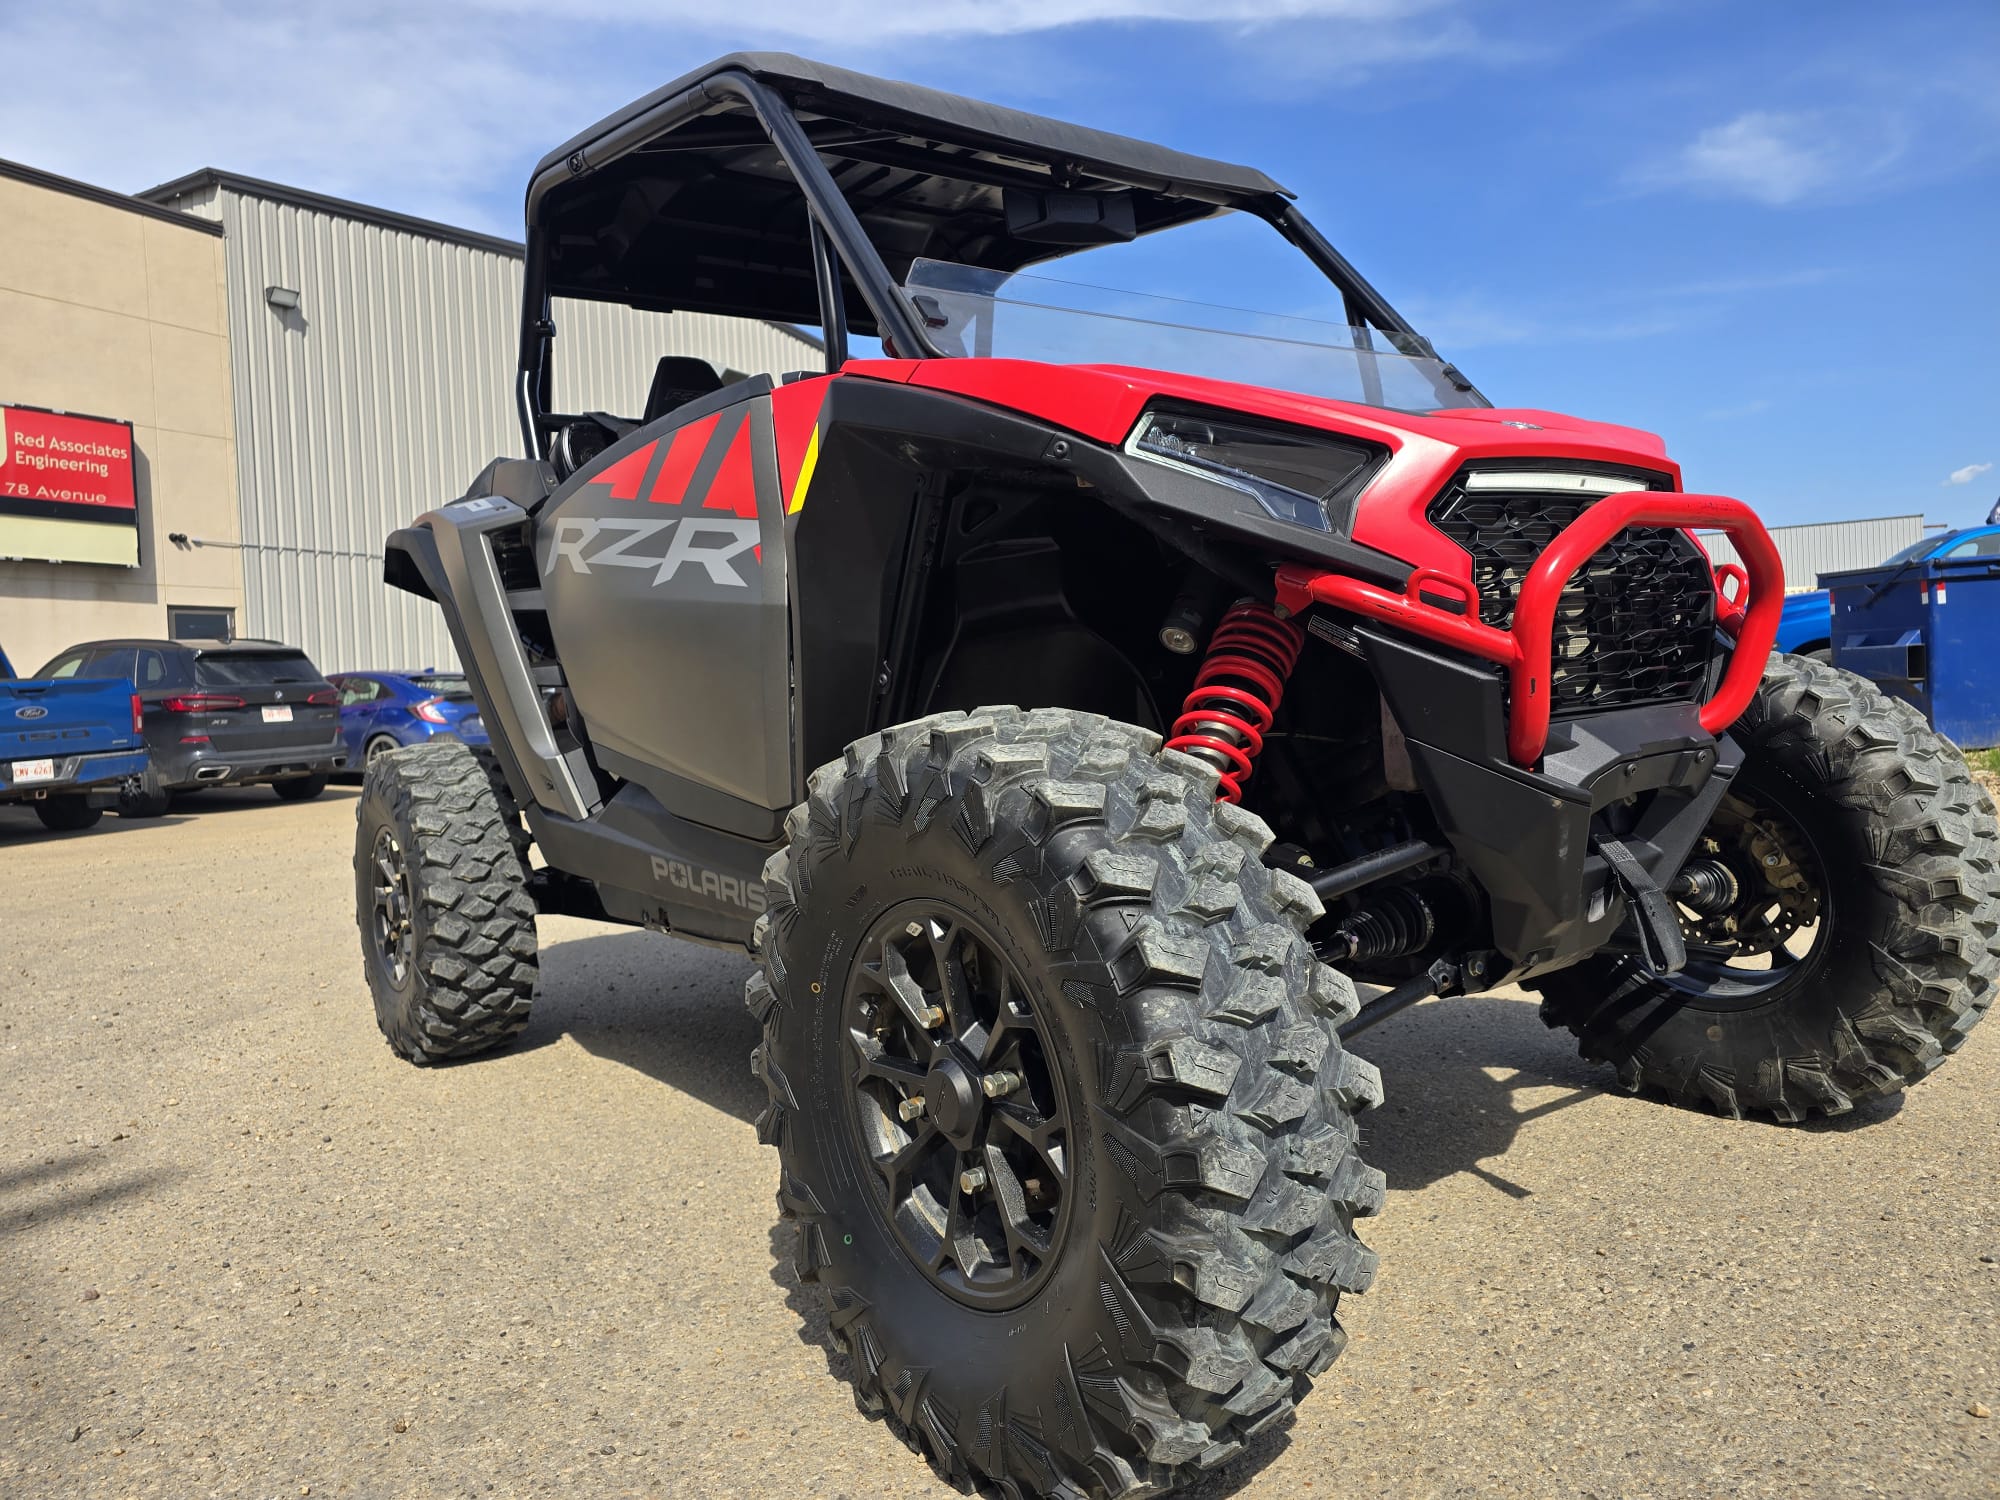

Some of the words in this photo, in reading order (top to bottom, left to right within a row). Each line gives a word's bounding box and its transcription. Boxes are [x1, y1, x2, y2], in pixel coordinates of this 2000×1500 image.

[14, 431, 45, 449] Red
[49, 436, 128, 460] Associates
[15, 450, 109, 477] Engineering
[5, 481, 30, 496] 78
[35, 485, 107, 504] Avenue
[544, 517, 761, 588] RZR
[650, 855, 767, 914] POLARIS
